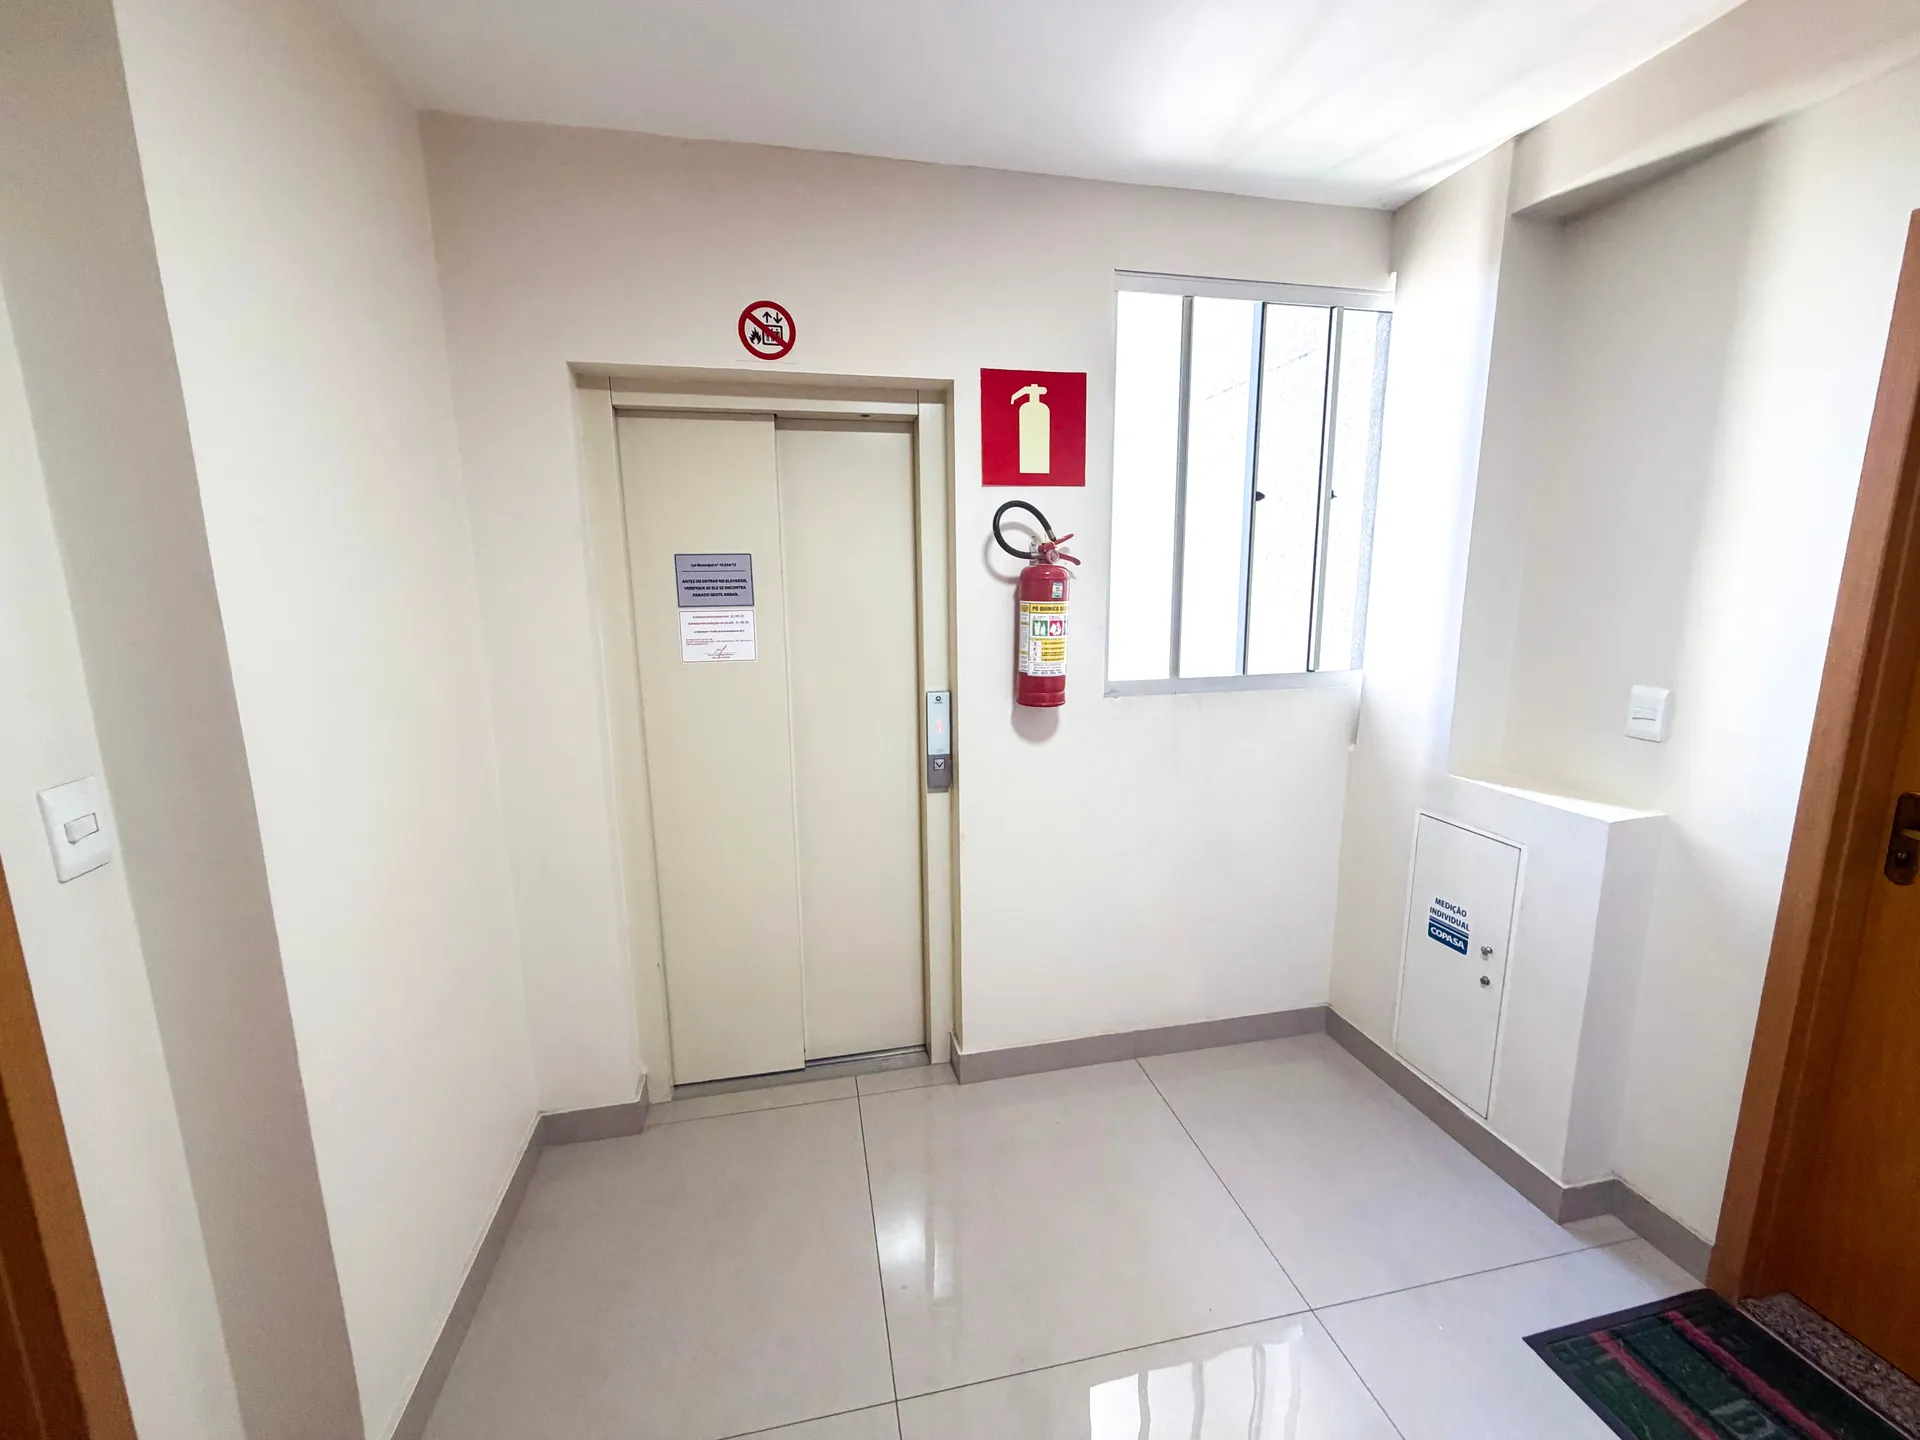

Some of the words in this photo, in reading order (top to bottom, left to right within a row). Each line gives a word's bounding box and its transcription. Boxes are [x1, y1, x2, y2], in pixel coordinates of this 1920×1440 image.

[1429, 906, 1470, 932] INDIVIDUAL
[1435, 897, 1467, 918] MEDIÇÃO
[1430, 926, 1465, 950] COPASA
